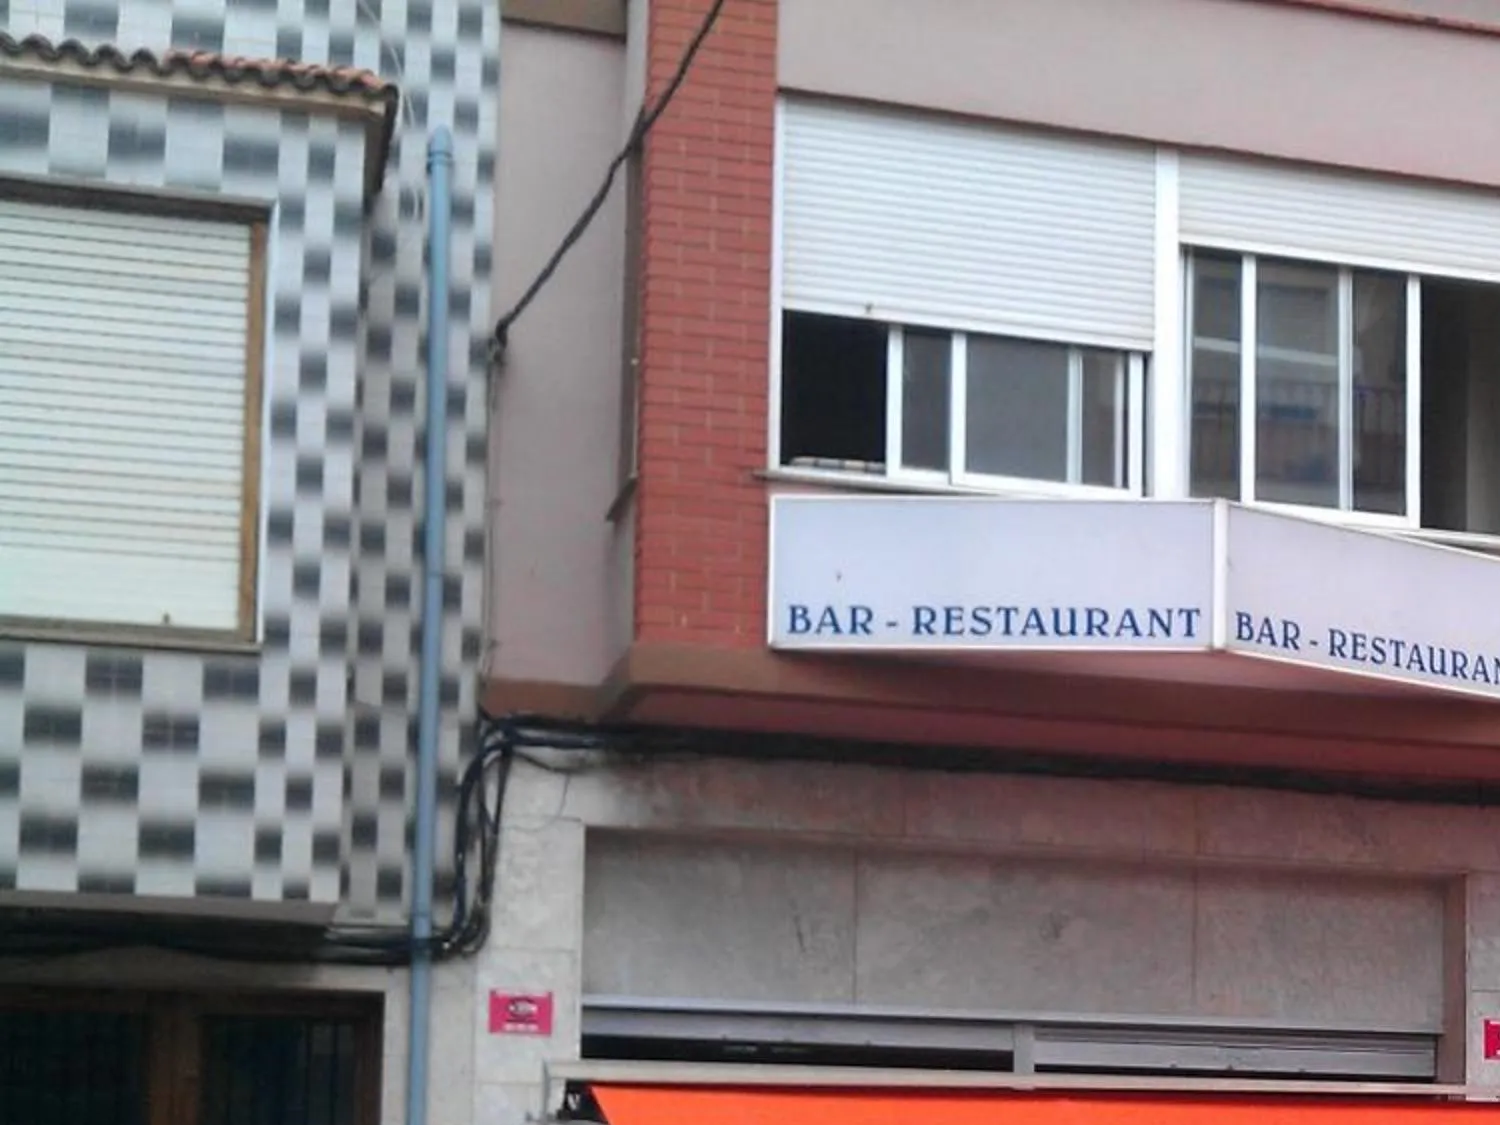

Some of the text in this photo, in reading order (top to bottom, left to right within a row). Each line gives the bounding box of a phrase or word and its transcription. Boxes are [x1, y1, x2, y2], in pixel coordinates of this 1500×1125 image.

[787, 604, 874, 636] BAR
[912, 606, 1202, 638] RESTAURANT
[1235, 611, 1301, 651] BAR
